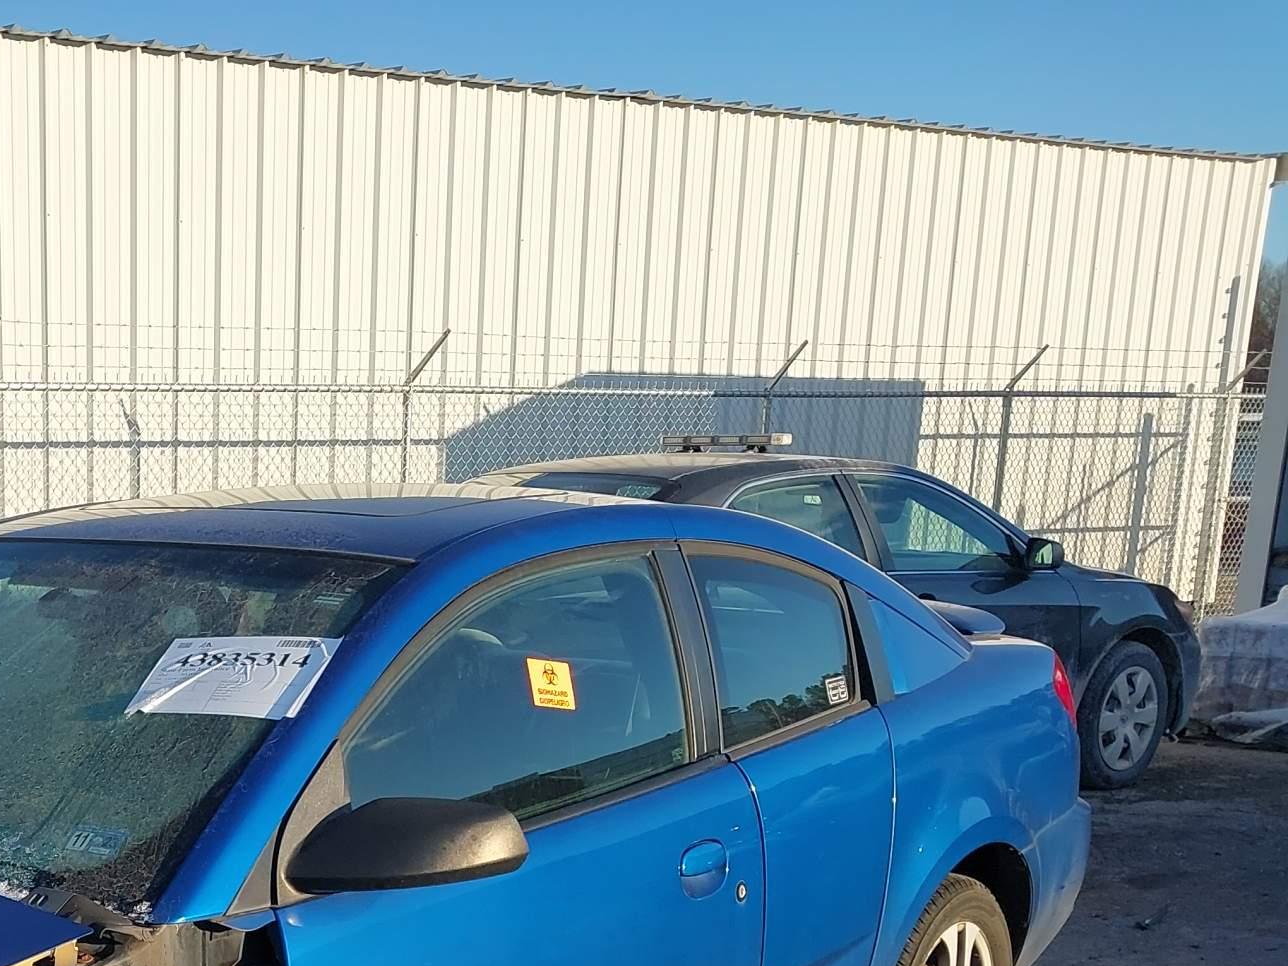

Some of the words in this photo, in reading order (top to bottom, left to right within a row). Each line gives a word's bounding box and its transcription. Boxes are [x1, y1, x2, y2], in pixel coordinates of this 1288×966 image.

[176, 652, 311, 668] 43835314
[537, 688, 568, 698] BIOHAZARD
[73, 832, 90, 848] 11
